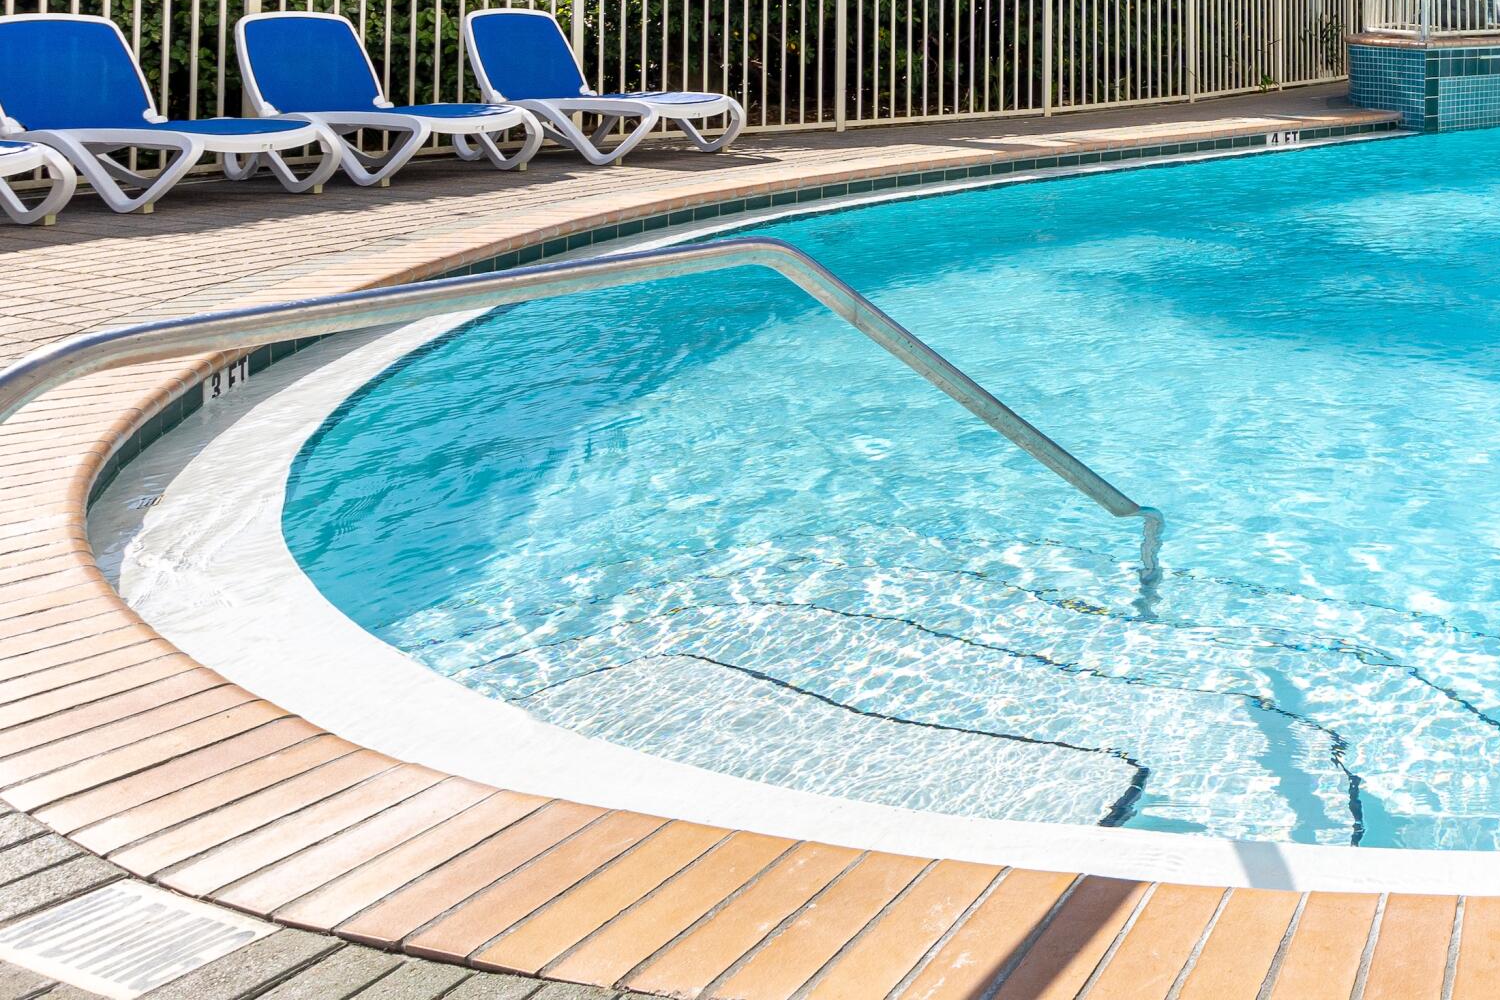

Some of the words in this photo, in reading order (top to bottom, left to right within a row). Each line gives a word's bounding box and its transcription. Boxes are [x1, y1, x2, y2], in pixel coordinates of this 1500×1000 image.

[1271, 132, 1279, 143] 4
[1284, 131, 1299, 143] FT
[211, 371, 221, 399] 3
[228, 355, 247, 389] FT
[0, 888, 143, 950] NO
[37, 902, 257, 991] DIVING
